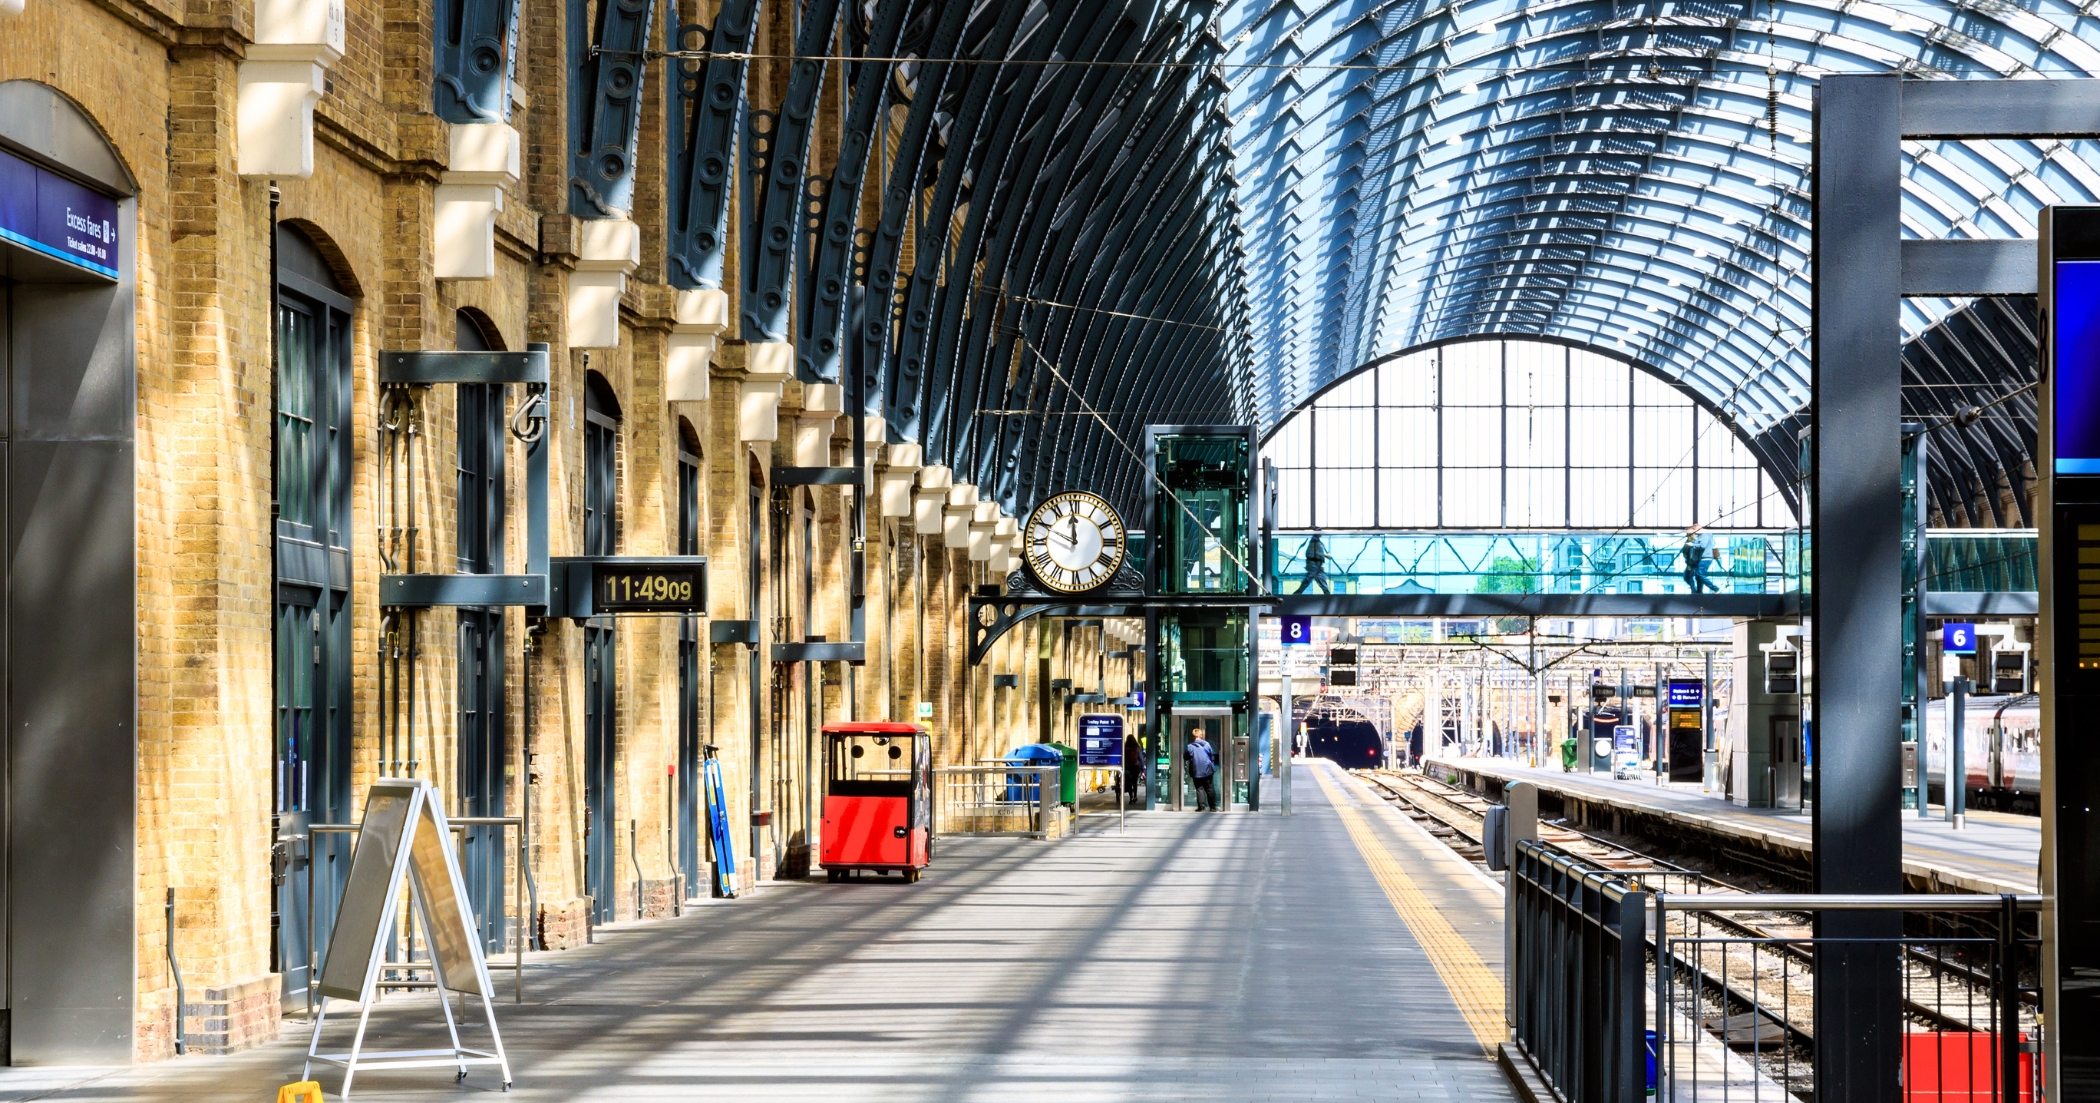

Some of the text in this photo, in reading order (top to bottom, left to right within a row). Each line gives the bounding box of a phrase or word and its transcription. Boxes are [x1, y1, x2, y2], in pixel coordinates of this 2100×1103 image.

[66, 206, 101, 239] Excess fares
[67, 236, 78, 250] Ticket
[78, 241, 86, 252] sales
[2039, 307, 2048, 384] 8
[1290, 622, 1302, 638] 8
[1953, 630, 1966, 646] 6
